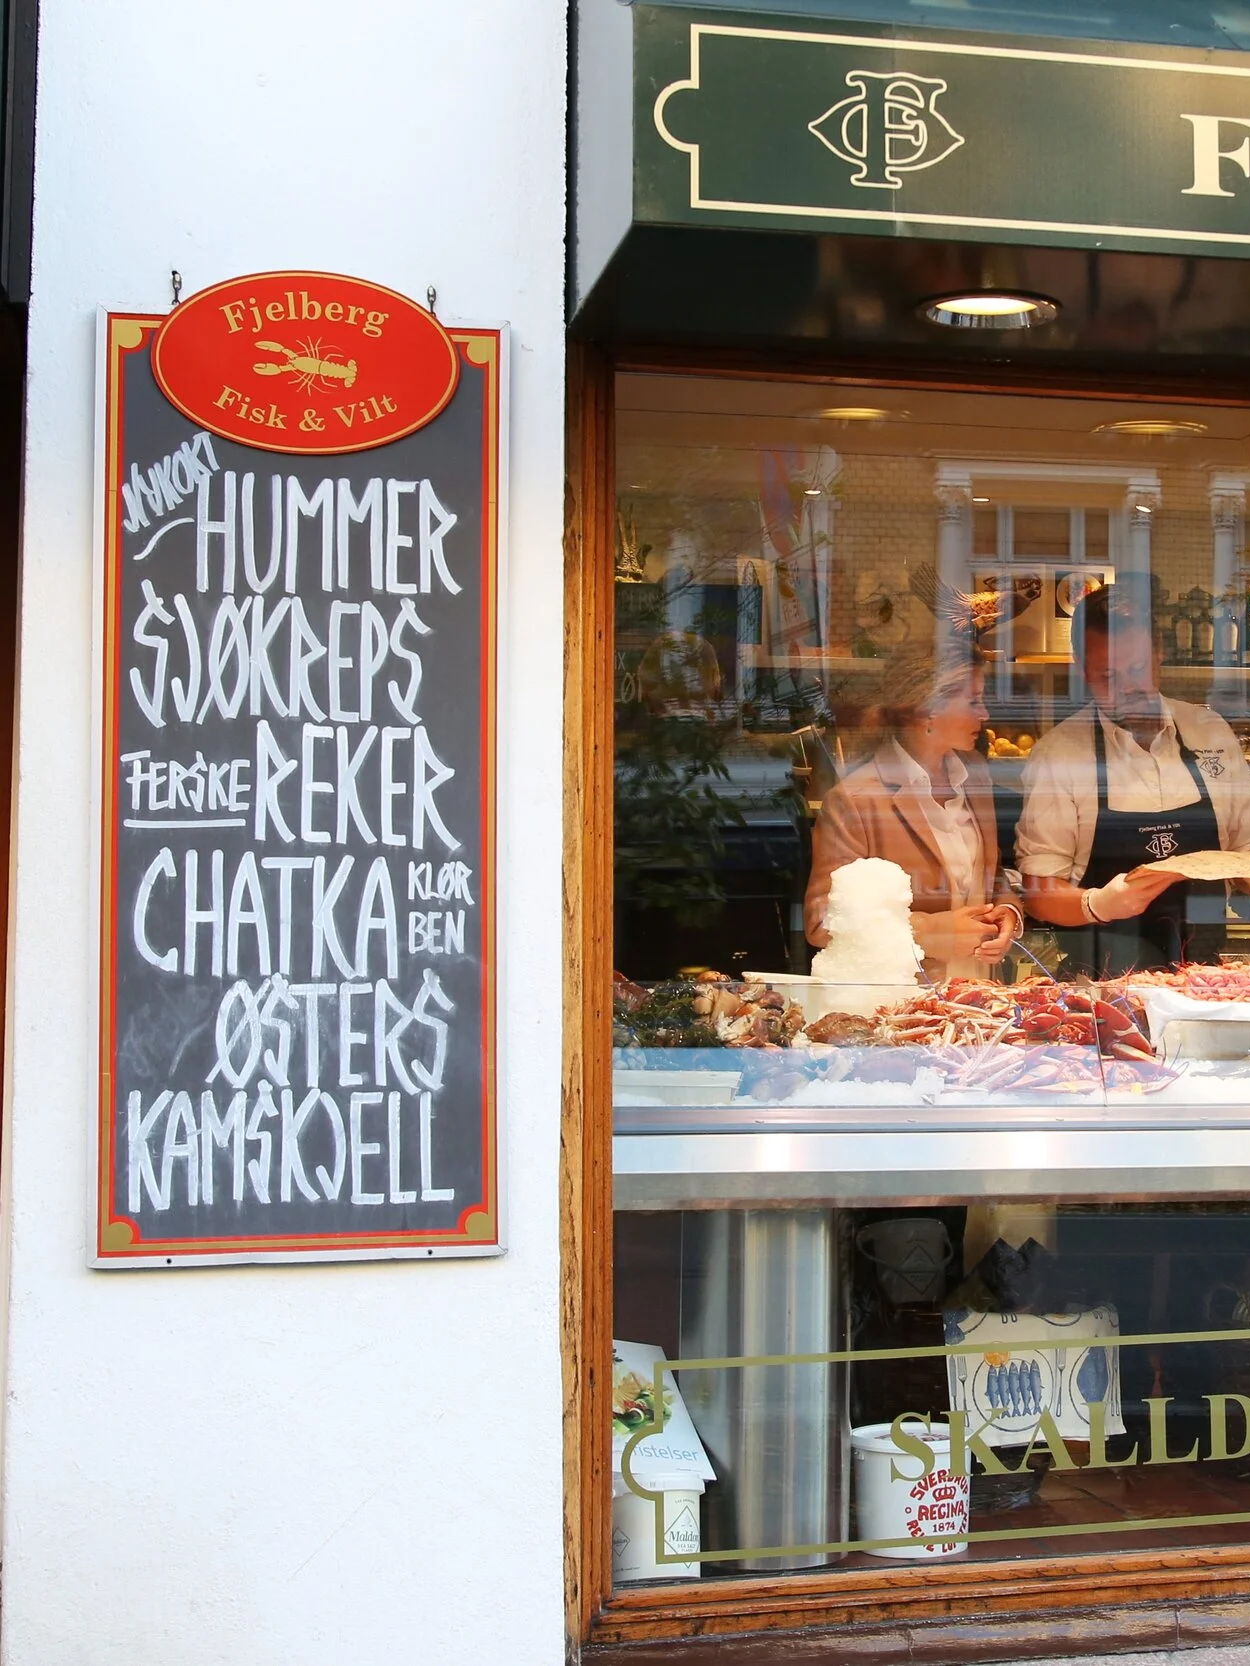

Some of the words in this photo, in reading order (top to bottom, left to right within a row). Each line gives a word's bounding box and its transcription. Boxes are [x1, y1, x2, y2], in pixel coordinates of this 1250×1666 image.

[218, 291, 390, 337] Fjelberg
[213, 384, 287, 430] Fisk
[299, 408, 326, 432] &
[333, 393, 398, 429] Vilt
[122, 432, 220, 533] NYKOKT
[196, 471, 463, 594] HUMMER
[130, 579, 430, 727] SJØKREPS
[120, 750, 252, 812] FERSKE
[254, 720, 462, 850] REKER
[133, 847, 398, 980] CHATKA
[408, 861, 475, 906] KLØR
[409, 909, 465, 955] BEN
[206, 968, 456, 1094] ØSTERS
[128, 1080, 455, 1212] KAMSKJELL
[918, 1500, 964, 1521] REGINA
[932, 1521, 955, 1533] 1874
